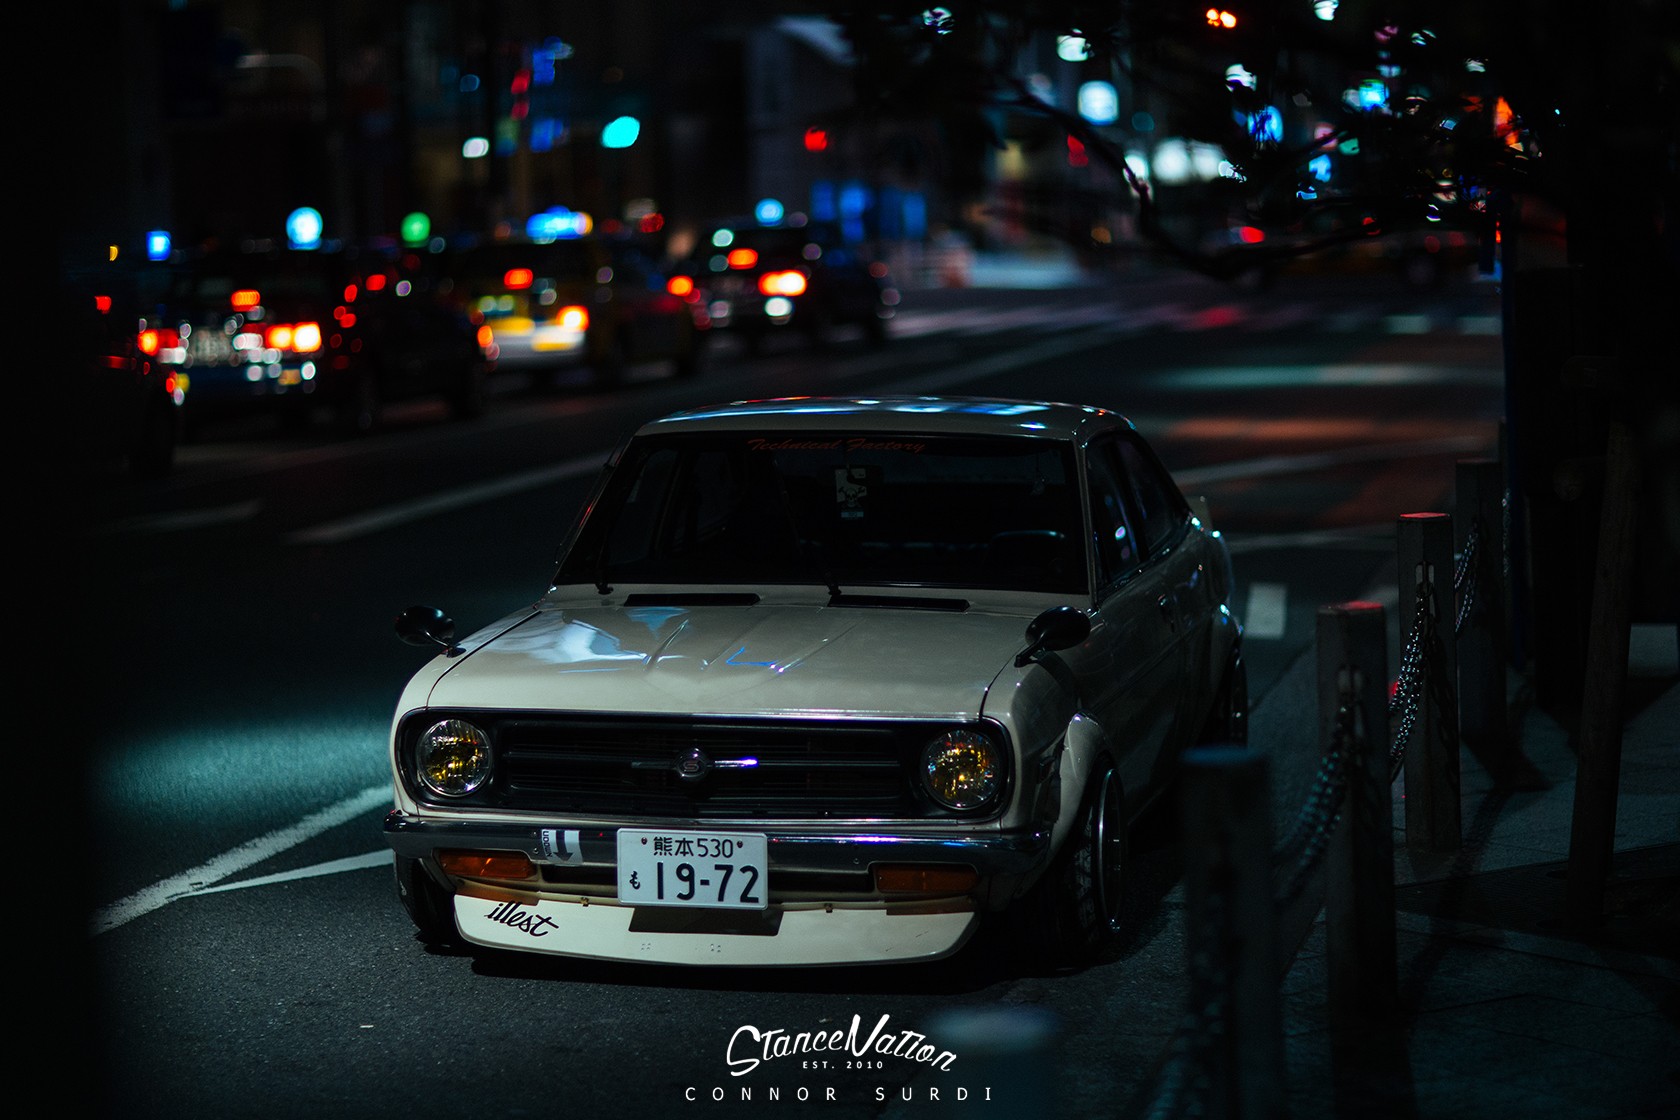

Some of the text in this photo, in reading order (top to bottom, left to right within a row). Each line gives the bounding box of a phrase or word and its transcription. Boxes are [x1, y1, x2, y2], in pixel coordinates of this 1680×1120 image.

[747, 437, 926, 454] Technical Factory
[657, 862, 760, 904] 19-72
[485, 900, 559, 937] illest
